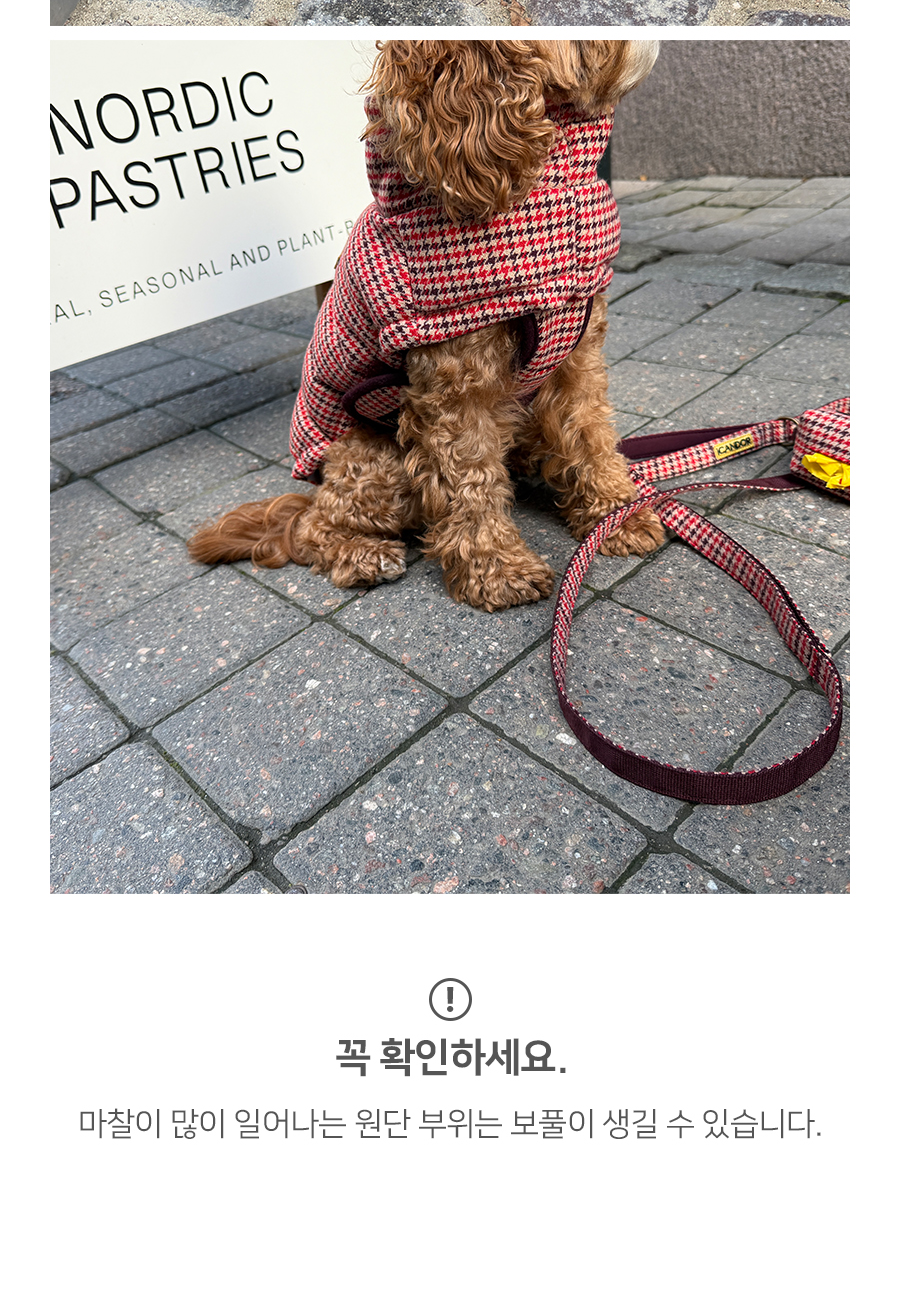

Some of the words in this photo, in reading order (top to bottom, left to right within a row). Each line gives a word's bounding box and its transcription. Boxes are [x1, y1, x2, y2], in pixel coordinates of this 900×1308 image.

[50, 71, 273, 155] NORDIC
[50, 129, 304, 228] PASTRIES
[50, 300, 92, 325] AL,
[99, 259, 223, 308] SEASONAL
[230, 245, 271, 271] AND
